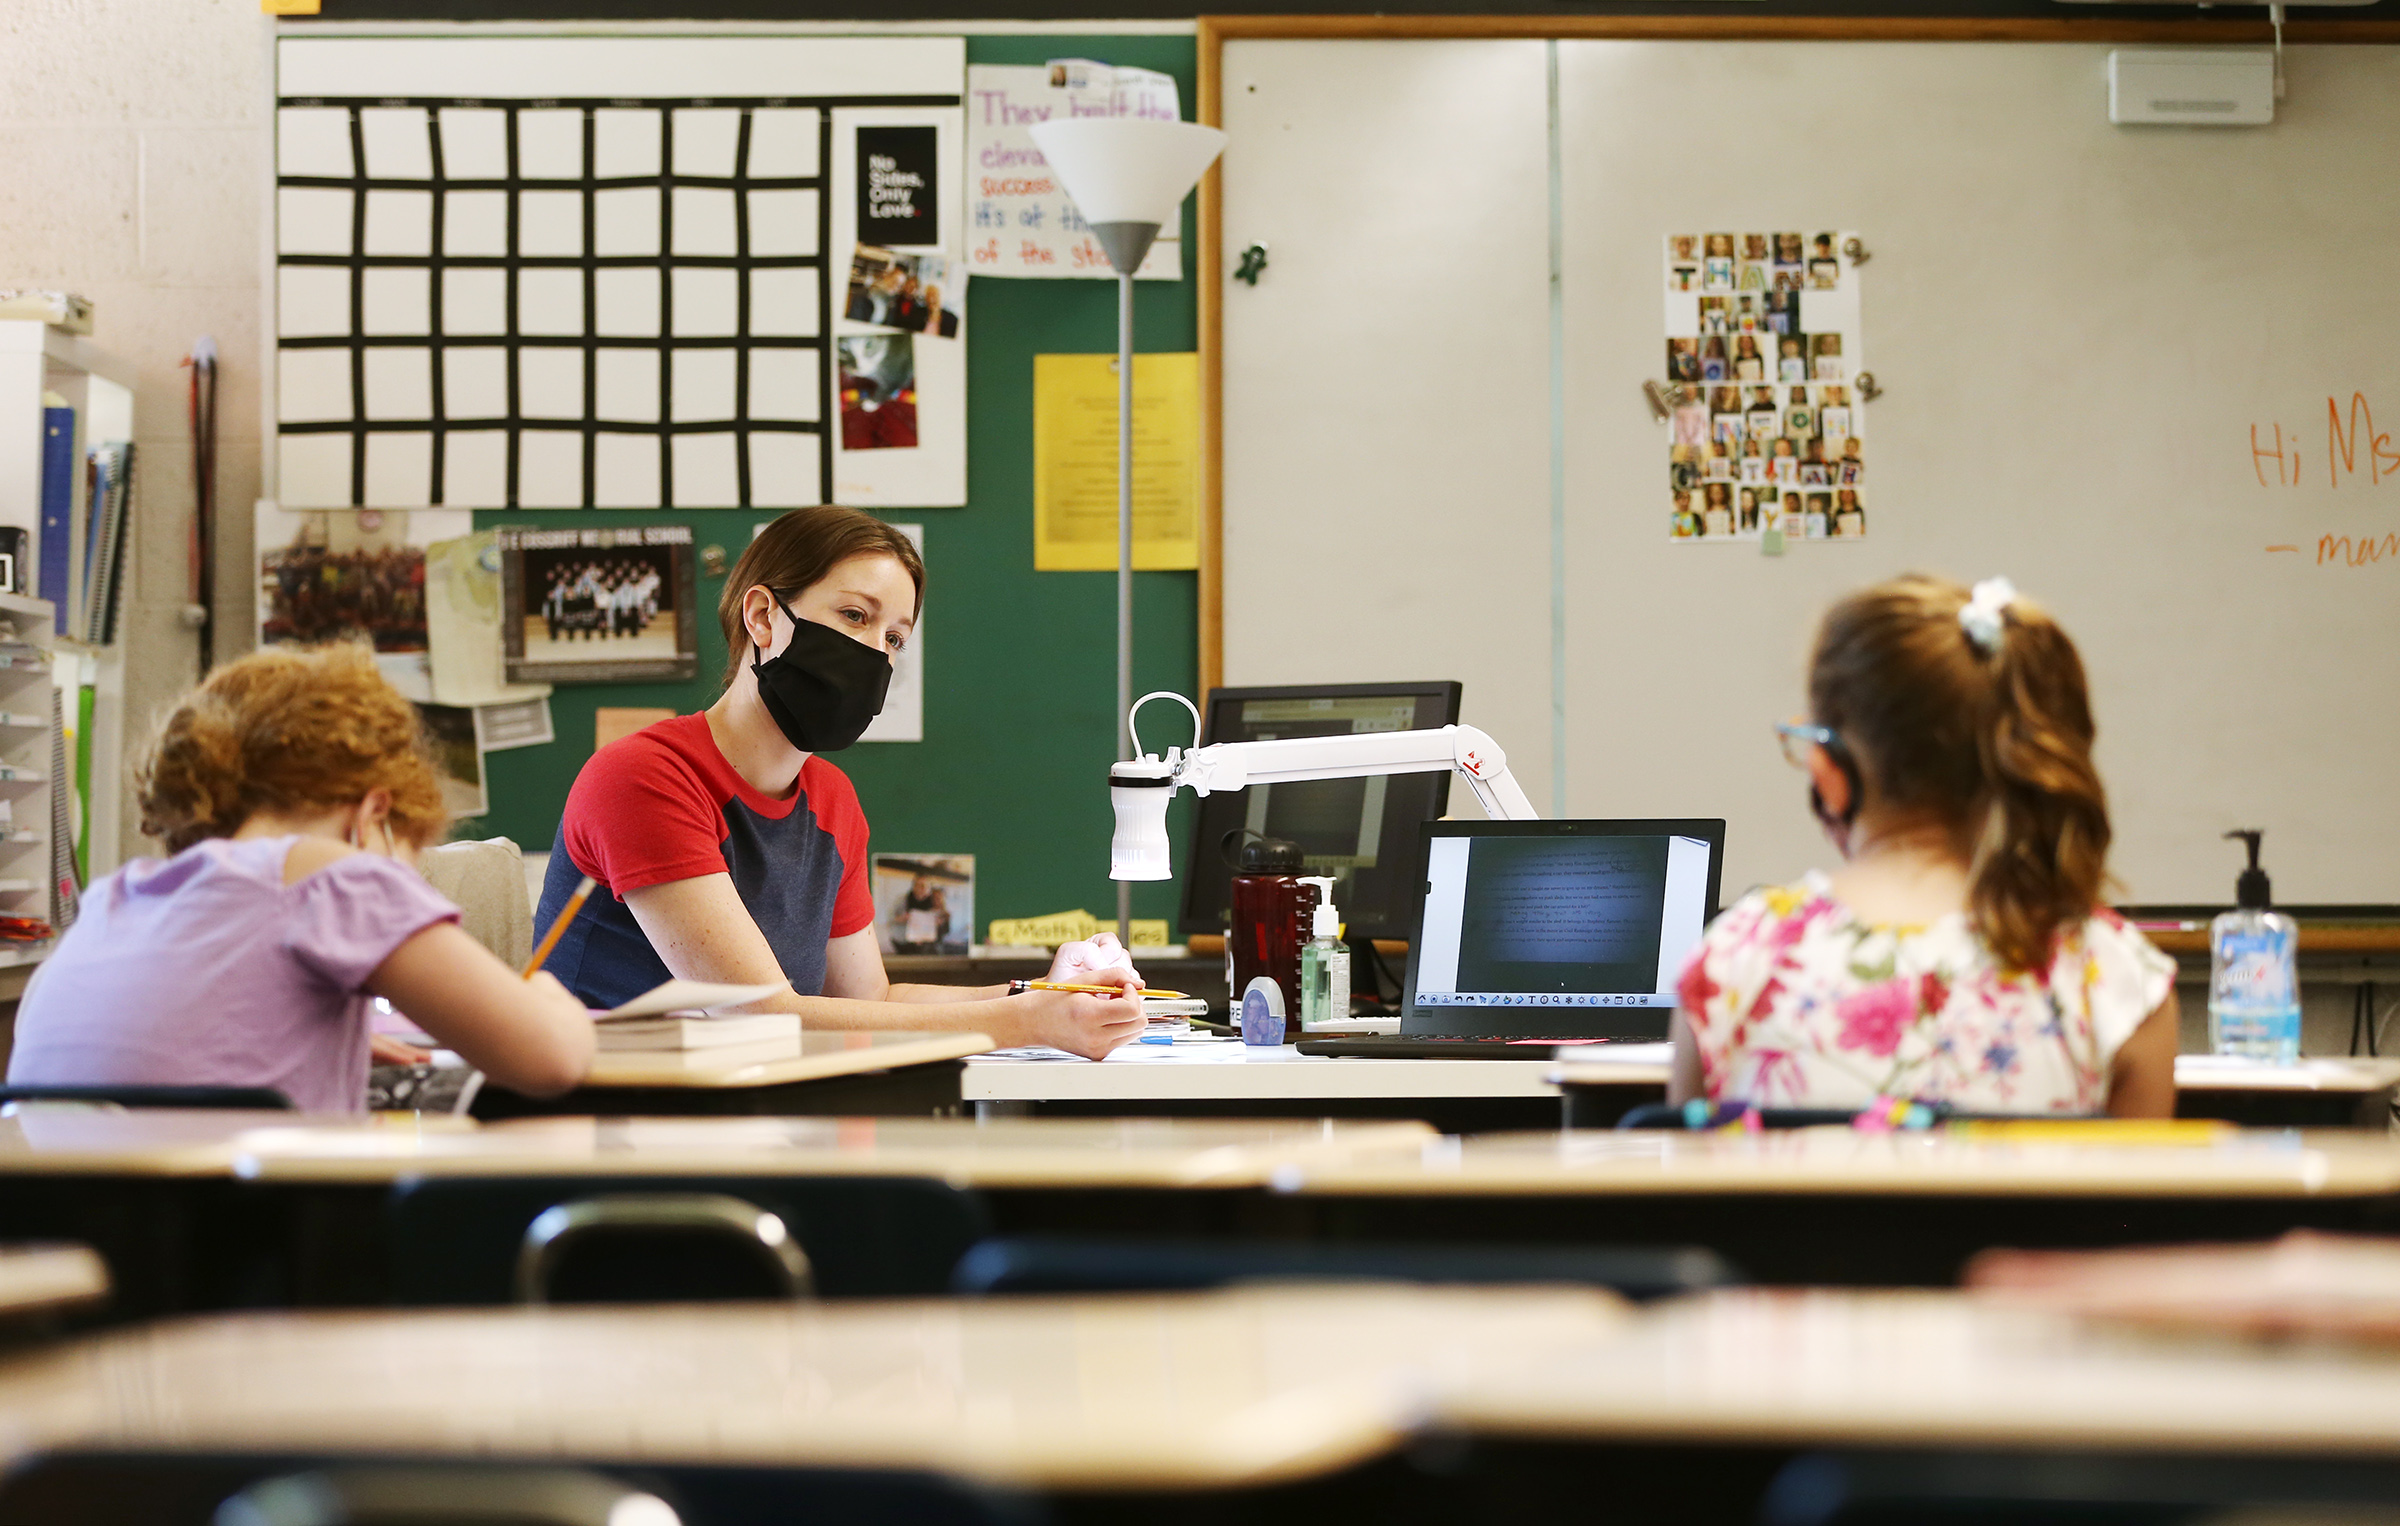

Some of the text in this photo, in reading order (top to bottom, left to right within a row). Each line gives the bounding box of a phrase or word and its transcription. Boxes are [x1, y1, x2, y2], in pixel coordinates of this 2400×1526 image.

[974, 91, 1051, 125] They
[868, 154, 897, 172] No
[868, 187, 913, 204] Only
[868, 202, 923, 218] Love.
[2250, 422, 2300, 487] Hi
[644, 526, 690, 545] SCHOOL
